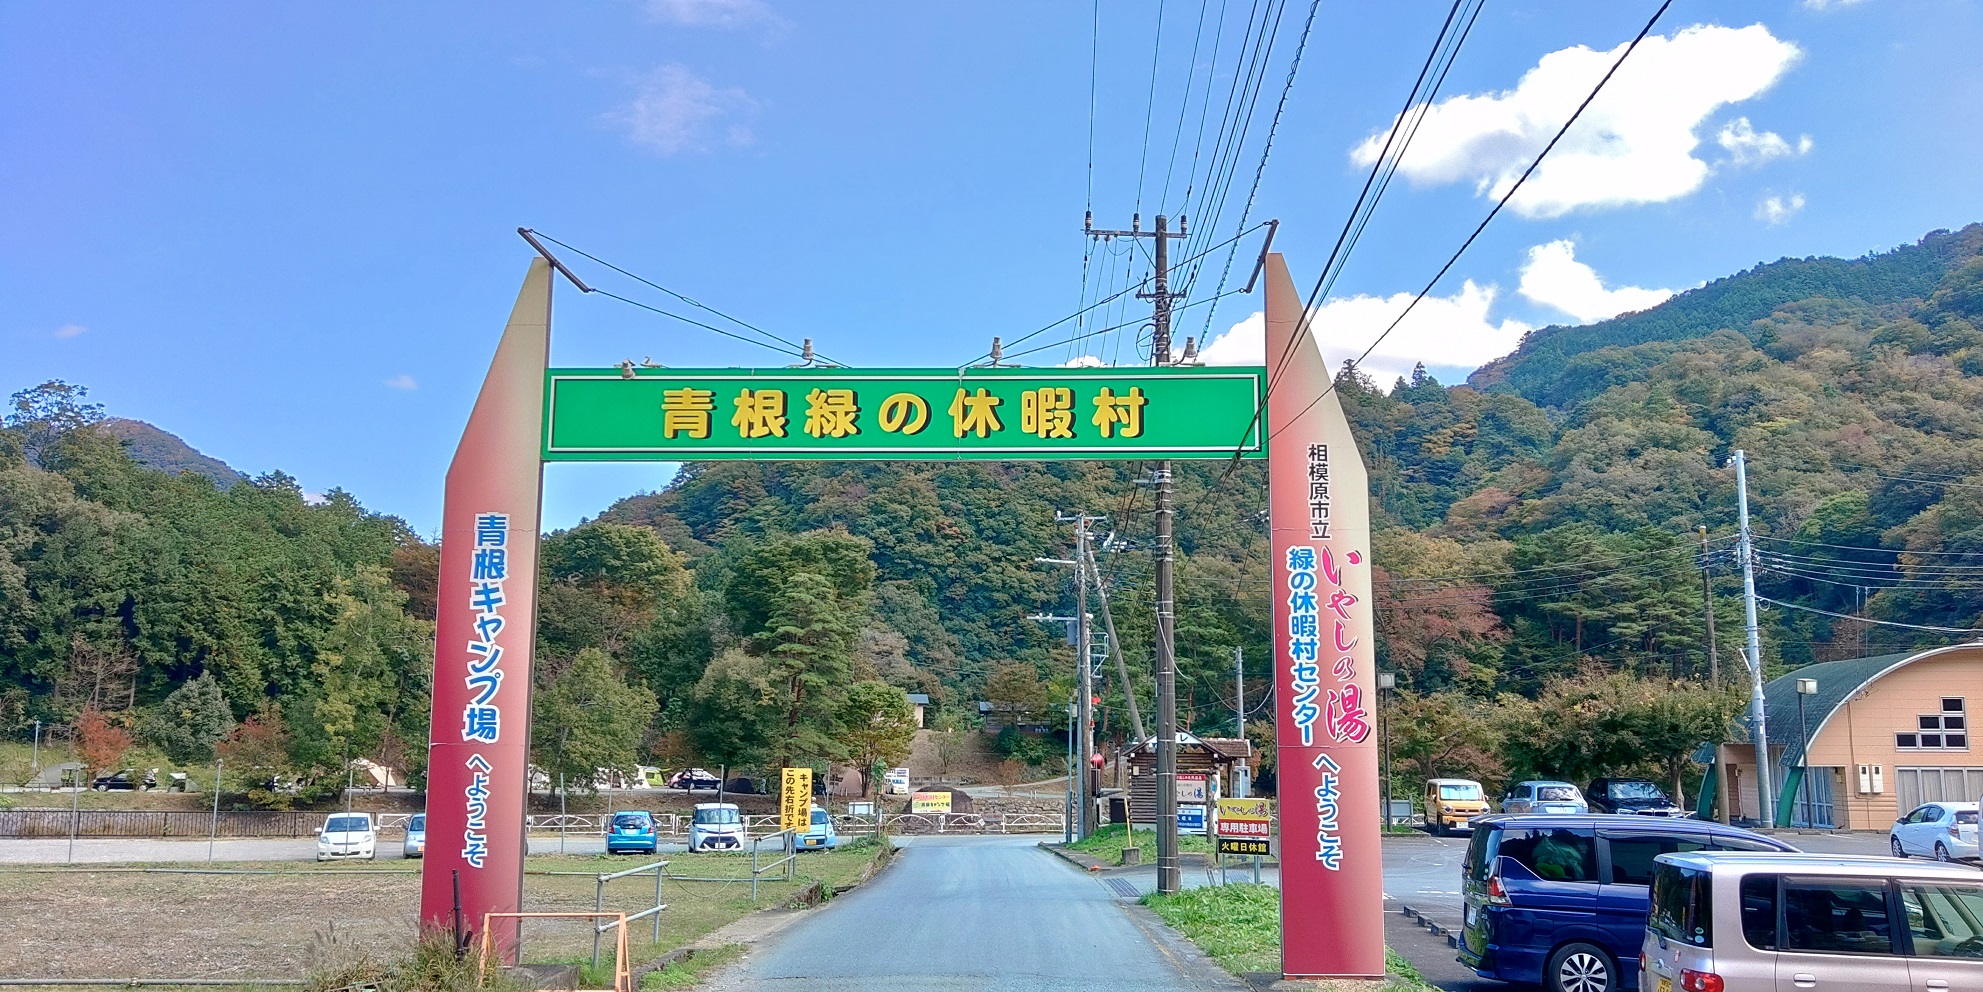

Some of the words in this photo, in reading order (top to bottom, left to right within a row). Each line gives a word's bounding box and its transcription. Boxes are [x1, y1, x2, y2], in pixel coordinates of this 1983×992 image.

[661, 387, 1149, 440] 青根緑の休暇村
[1307, 442, 1331, 540] 相模原市立
[463, 513, 509, 743] 青根キャンプ場
[1287, 546, 1320, 745] 緑の休暇村センター
[1320, 545, 1371, 743] いやしの湯
[463, 753, 494, 868] へようこそ
[798, 773, 808, 826] キャンプ場は
[1220, 822, 1268, 834] 専用駐車場
[1221, 841, 1267, 853] 火曜日休館
[1312, 753, 1343, 871] へようこそ
